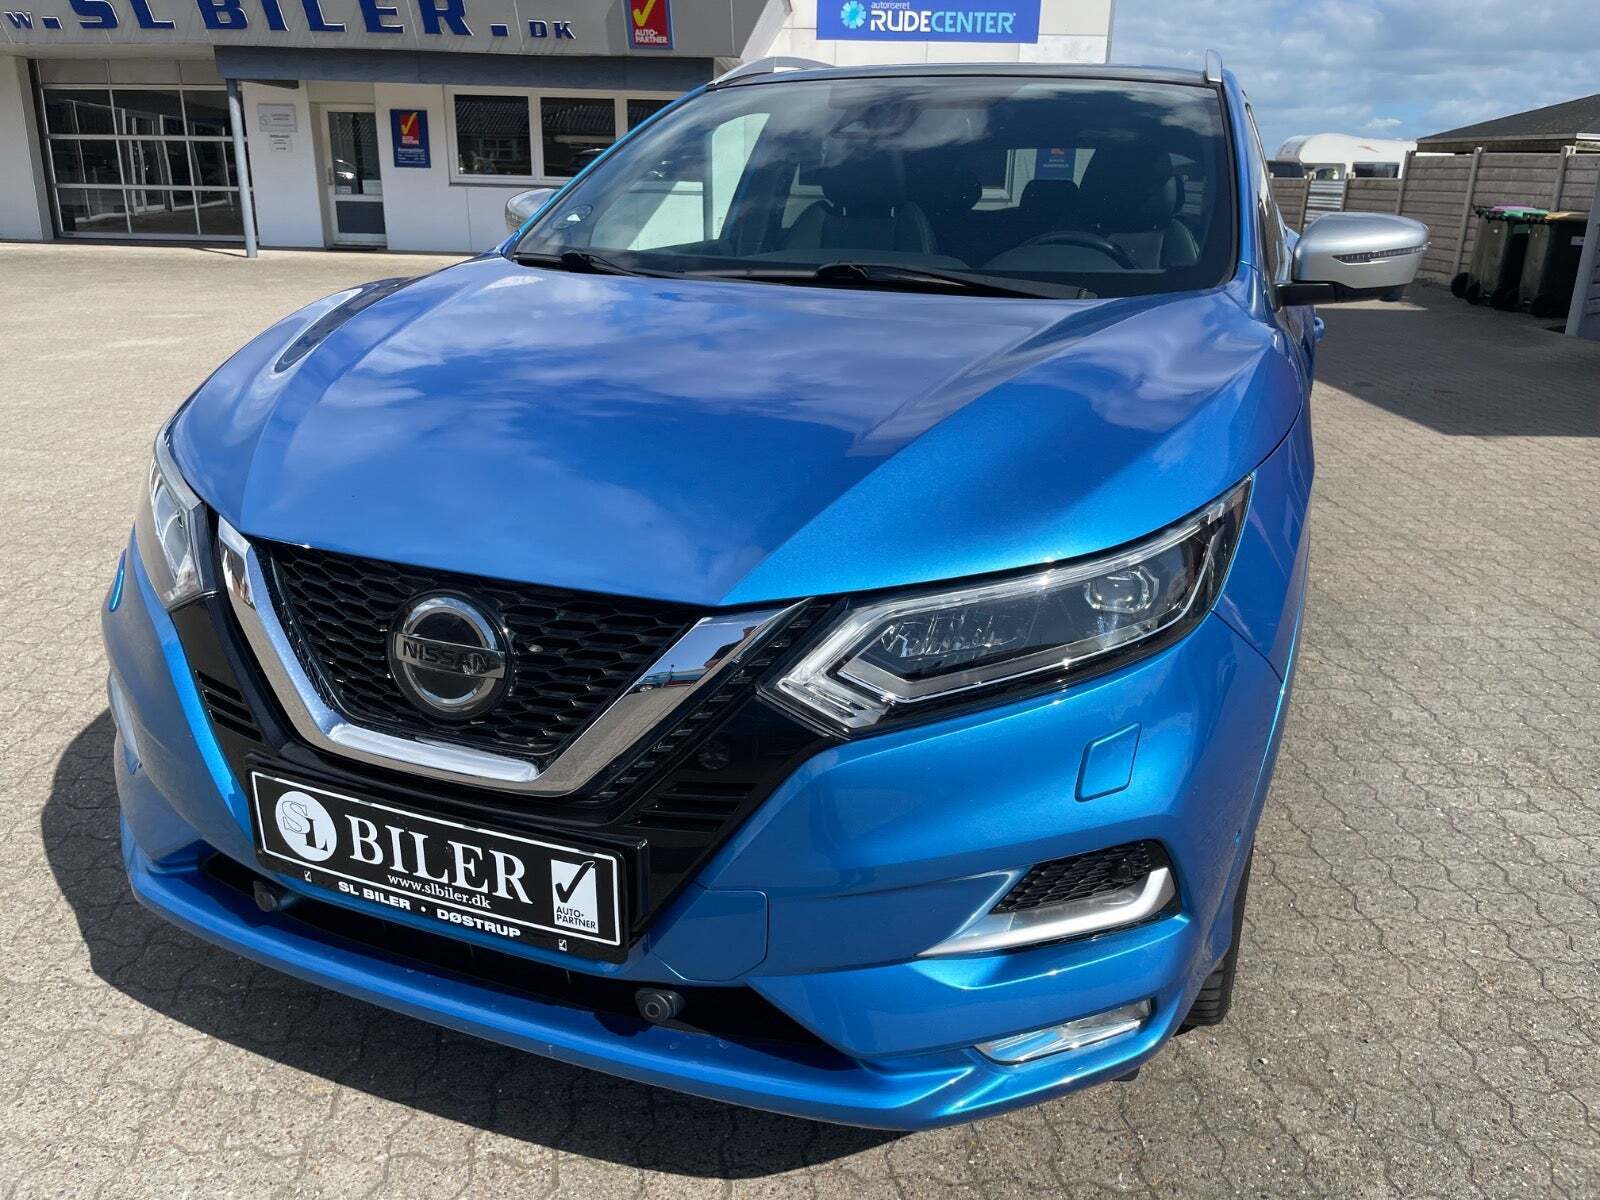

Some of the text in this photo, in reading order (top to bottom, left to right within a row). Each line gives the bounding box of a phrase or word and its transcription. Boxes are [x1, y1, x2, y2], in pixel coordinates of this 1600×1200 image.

[870, 1, 910, 10] autoriseret
[870, 10, 1016, 34] RUDECENTER
[635, 36, 668, 44] PARTNER
[403, 640, 488, 676] NISSAN
[344, 814, 534, 905] BILER
[387, 874, 492, 909] www.slbiler.dk
[337, 881, 521, 938] SL BILER DØSTRUP
[556, 914, 597, 930] PARTNER
